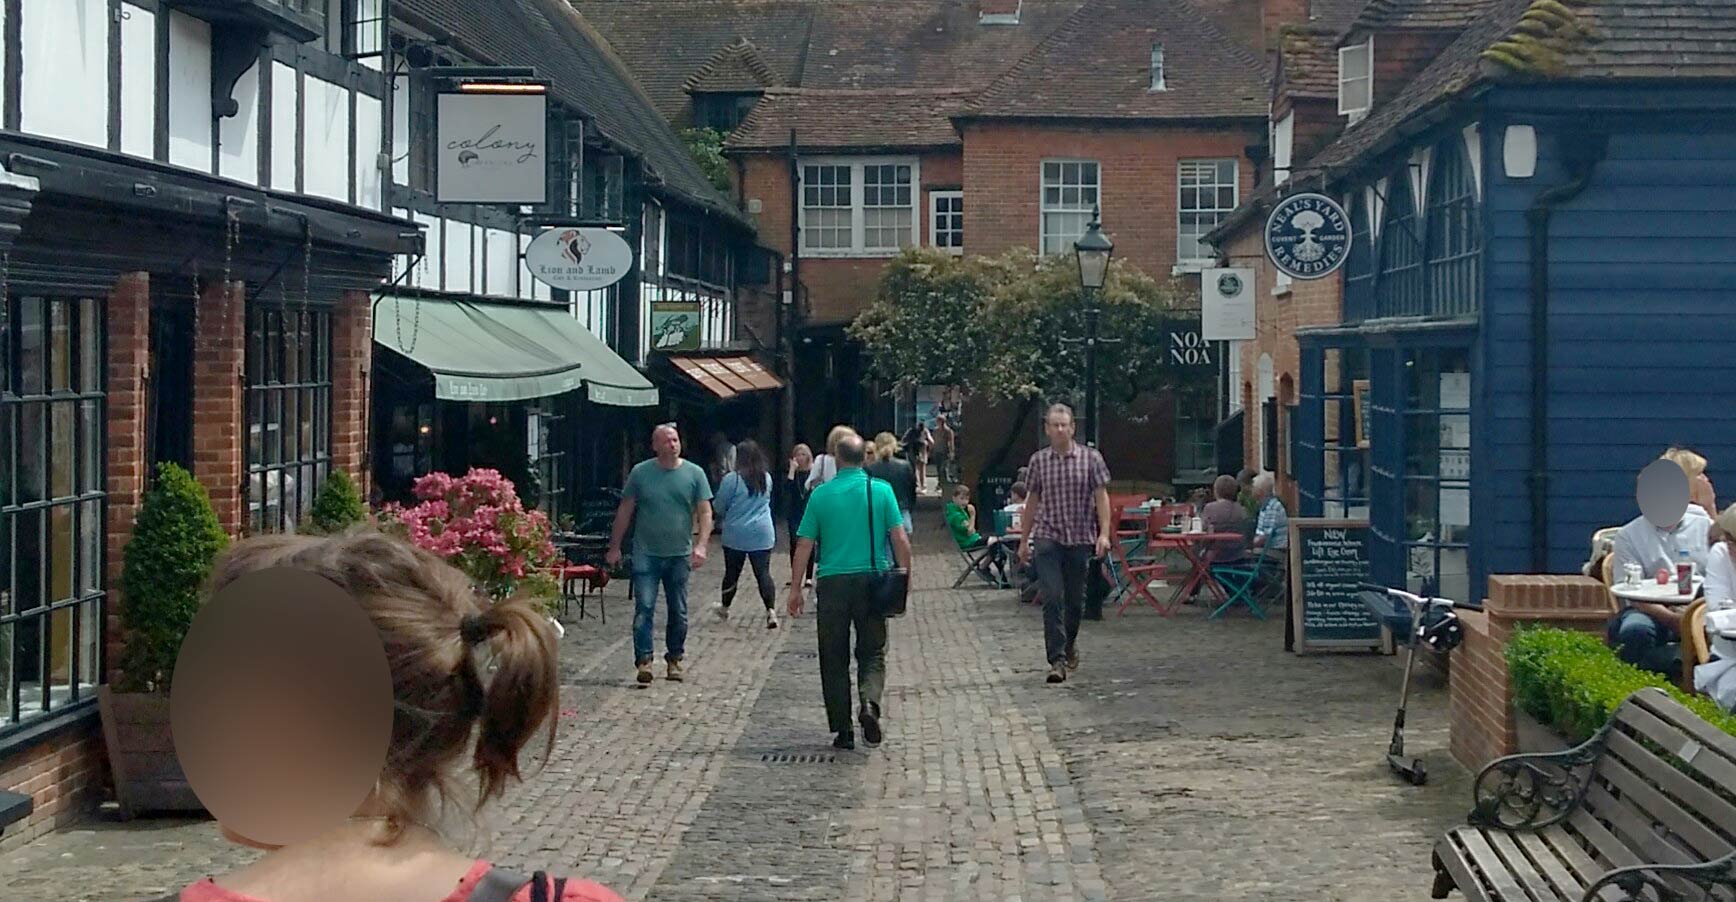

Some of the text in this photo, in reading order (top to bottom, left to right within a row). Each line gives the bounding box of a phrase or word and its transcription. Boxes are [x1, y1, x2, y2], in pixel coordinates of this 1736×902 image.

[447, 124, 537, 164] colony
[1272, 199, 1344, 233] NEAL'S YARD
[539, 264, 616, 275] Lion and Lamb
[1274, 244, 1343, 273] REMEDIES
[1170, 348, 1211, 365] NOA
